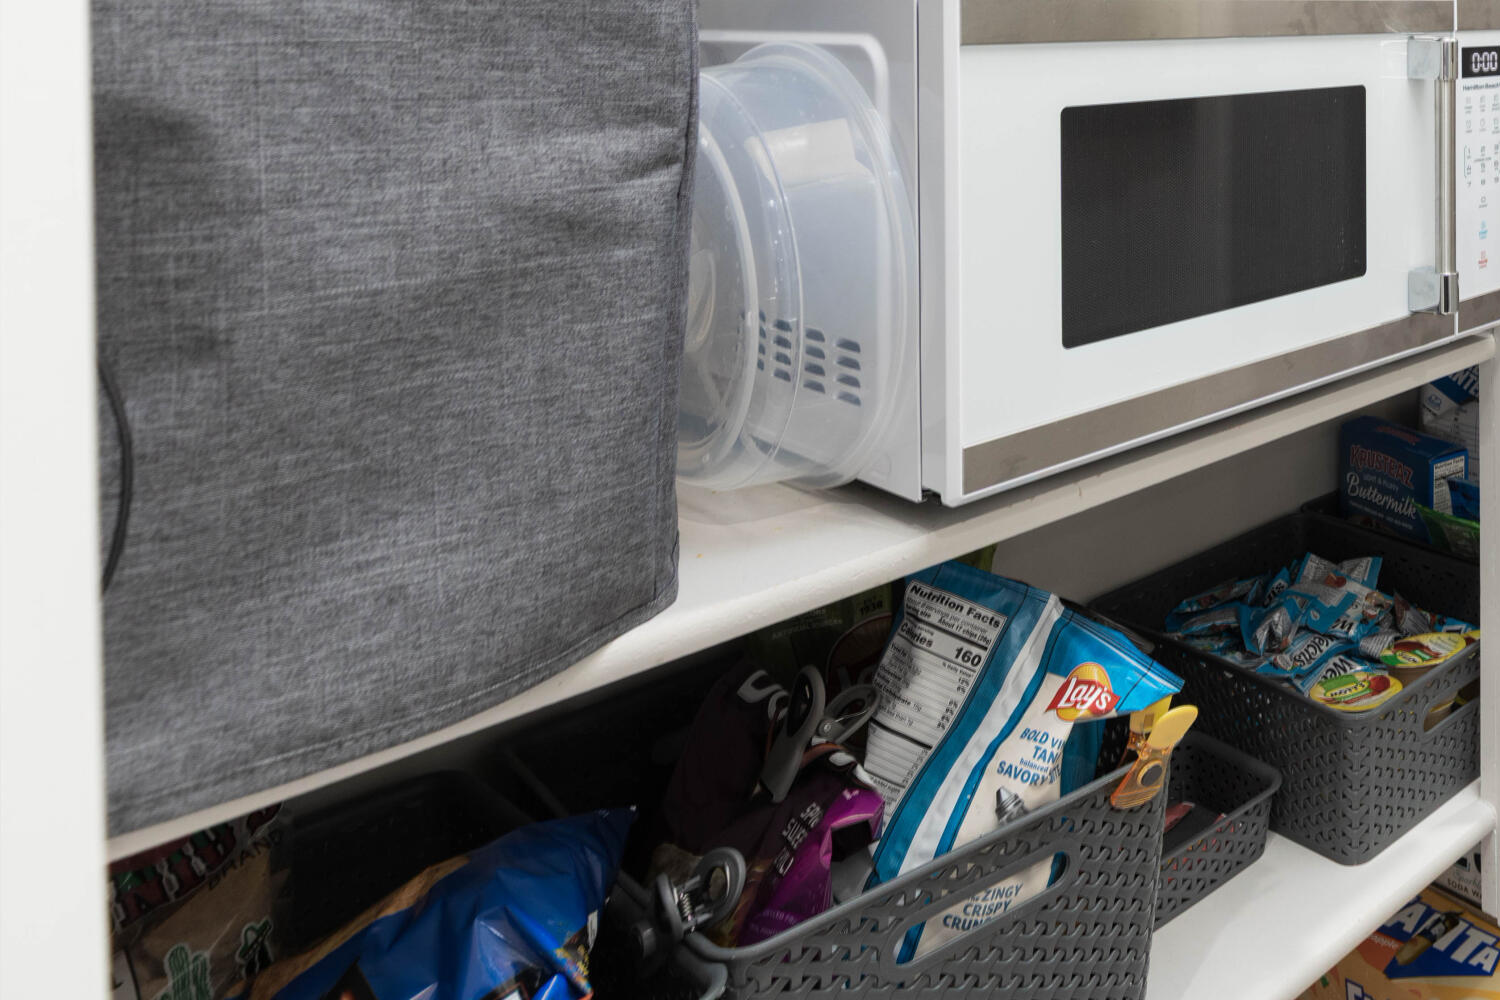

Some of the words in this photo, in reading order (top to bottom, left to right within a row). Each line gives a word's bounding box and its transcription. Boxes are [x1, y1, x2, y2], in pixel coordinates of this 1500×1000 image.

[1471, 51, 1498, 73] 0:00
[1350, 445, 1415, 489] KRUSTEAZ
[1346, 472, 1417, 520] Buttermilk
[910, 584, 965, 613] Nutrition
[966, 606, 1001, 629] Facts
[954, 646, 982, 667] 160
[1057, 677, 1111, 710] Lay's
[1020, 727, 1049, 745] BOLD
[996, 760, 1048, 787] SAVORY
[1019, 757, 1049, 773] balanced
[983, 883, 1022, 900] ZINGY
[962, 900, 1012, 918] CRISPY
